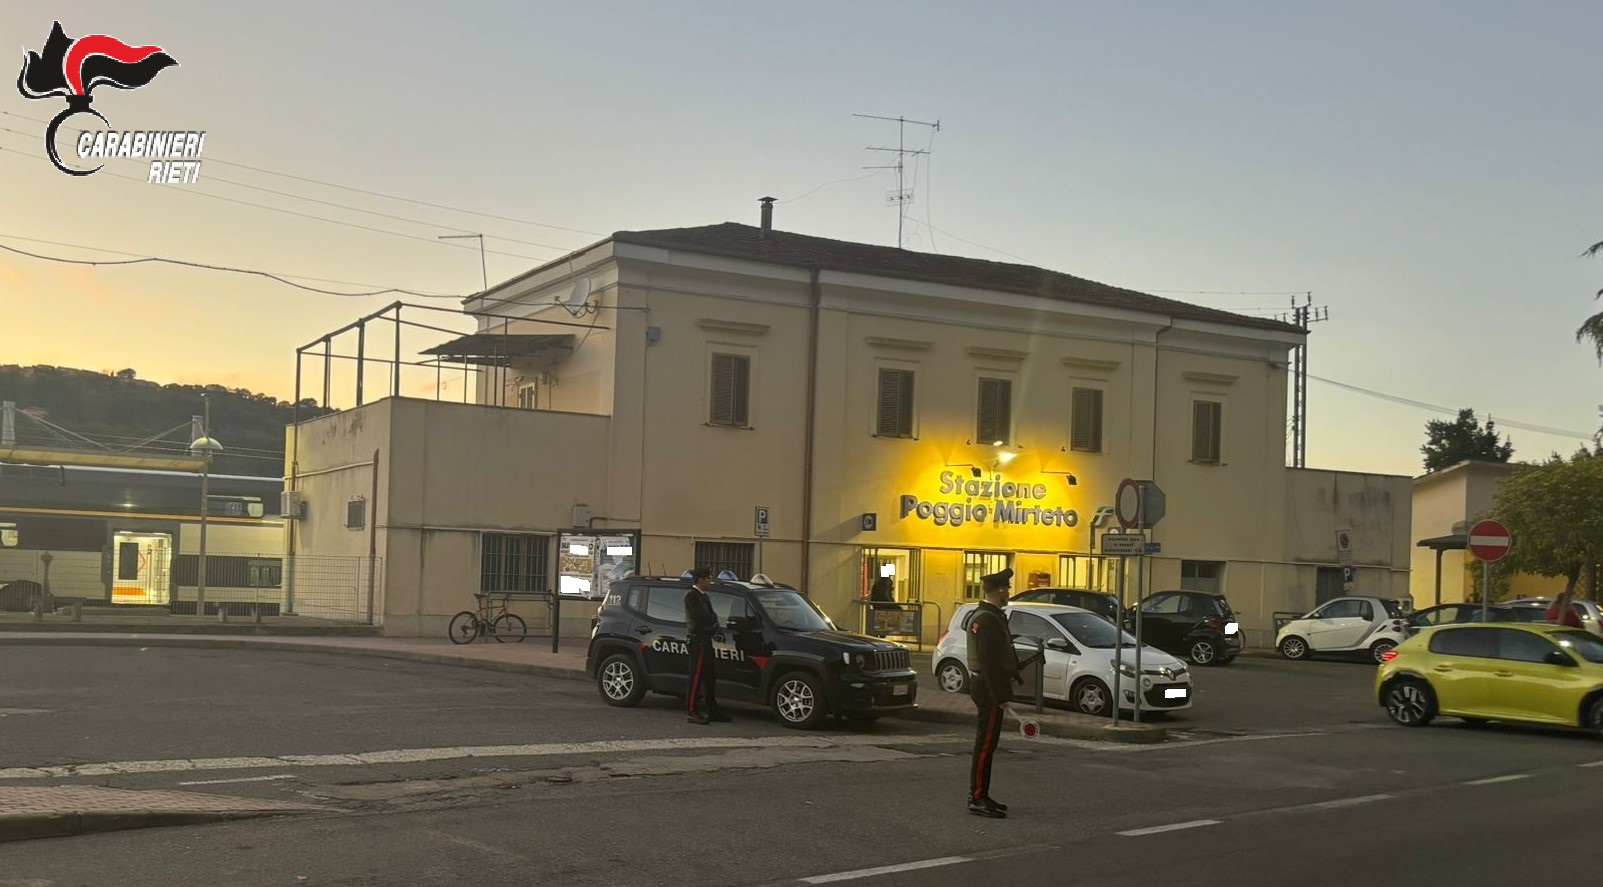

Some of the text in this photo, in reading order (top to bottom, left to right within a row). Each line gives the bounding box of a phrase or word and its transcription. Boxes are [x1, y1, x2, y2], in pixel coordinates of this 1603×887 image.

[939, 470, 1047, 499] Stazione
[758, 509, 767, 523] P
[900, 494, 1078, 527] Poggio Mirteto
[609, 595, 621, 605] 112
[652, 639, 745, 662] CARAIERI
